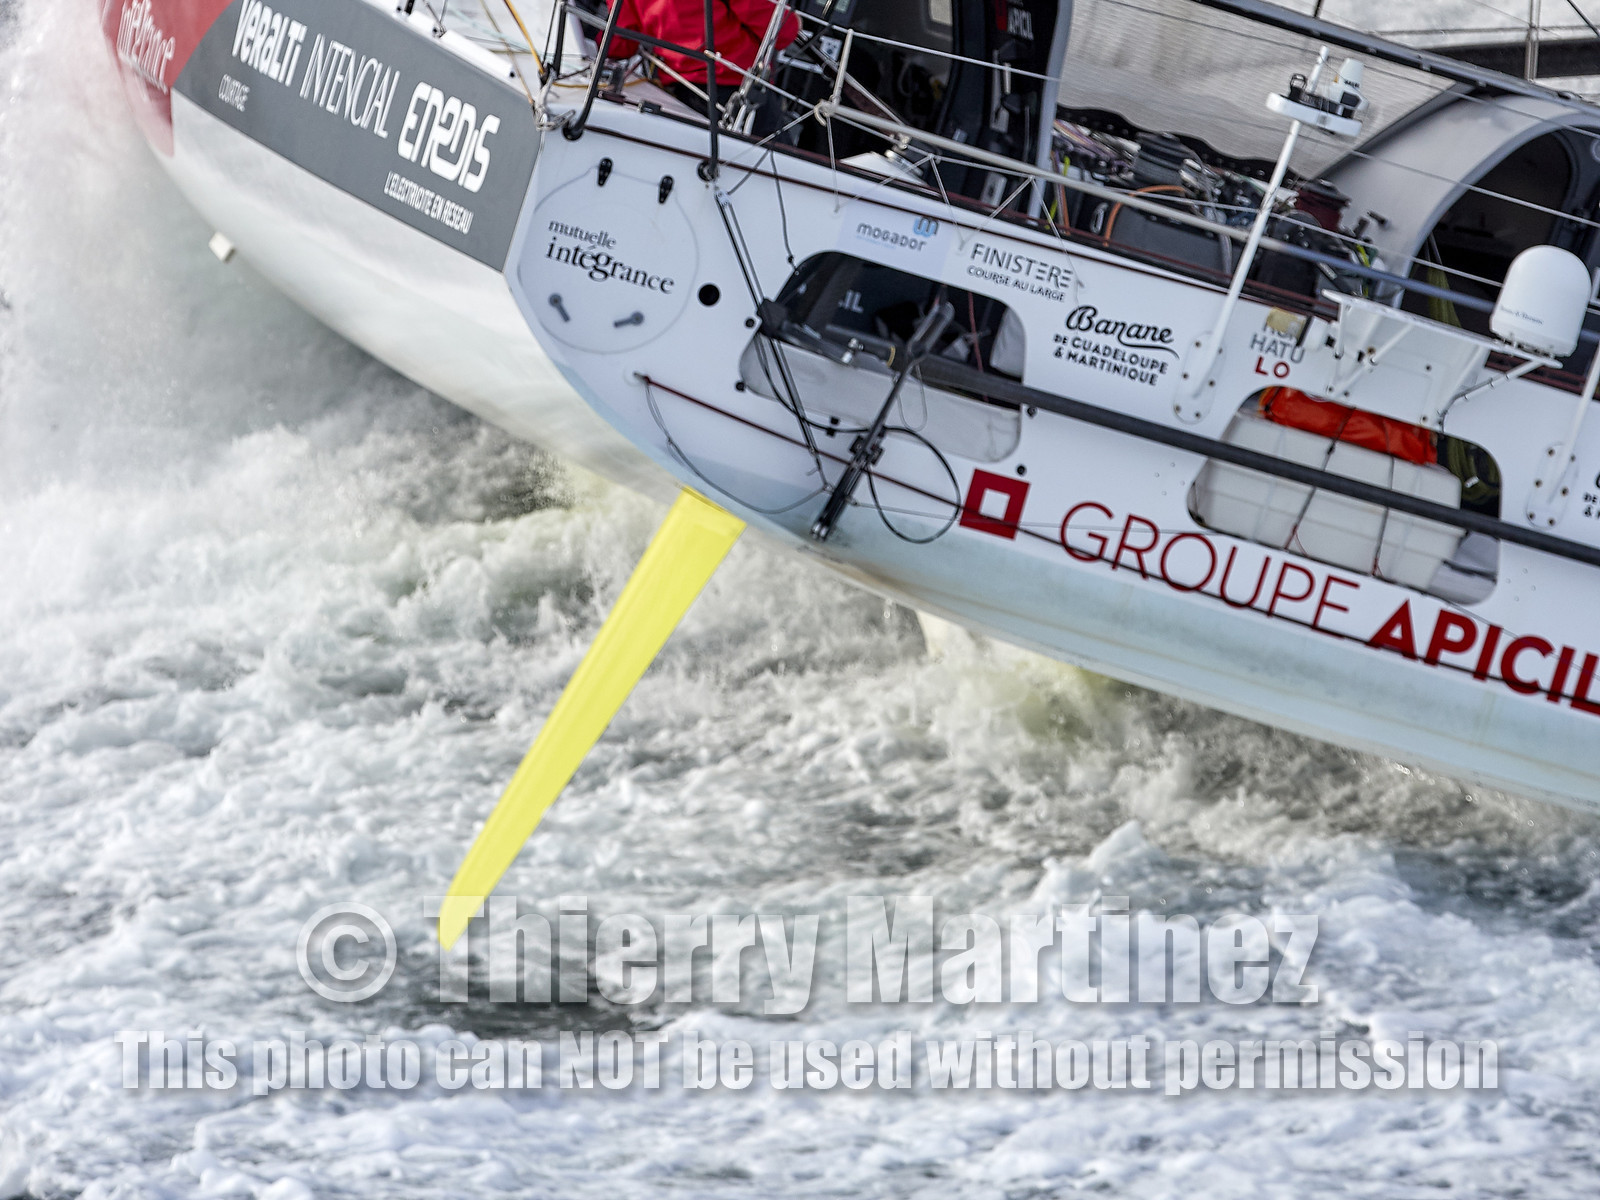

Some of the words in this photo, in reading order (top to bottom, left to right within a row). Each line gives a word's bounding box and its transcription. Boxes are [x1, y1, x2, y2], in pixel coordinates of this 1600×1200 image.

[300, 33, 400, 139] INTENCIAL
[548, 220, 617, 249] mutuelle
[546, 236, 674, 294] intégrance
[967, 264, 1010, 285] COURSE
[1012, 278, 1030, 292] AU
[1029, 282, 1066, 302] LARGE
[1053, 333, 1069, 346] DE
[1066, 304, 1180, 359] Banane
[1053, 347, 1064, 359] &
[1067, 350, 1159, 386] MARTINIQUE
[1060, 501, 1361, 639] GROUPE
[1365, 598, 1600, 718] APICIL
